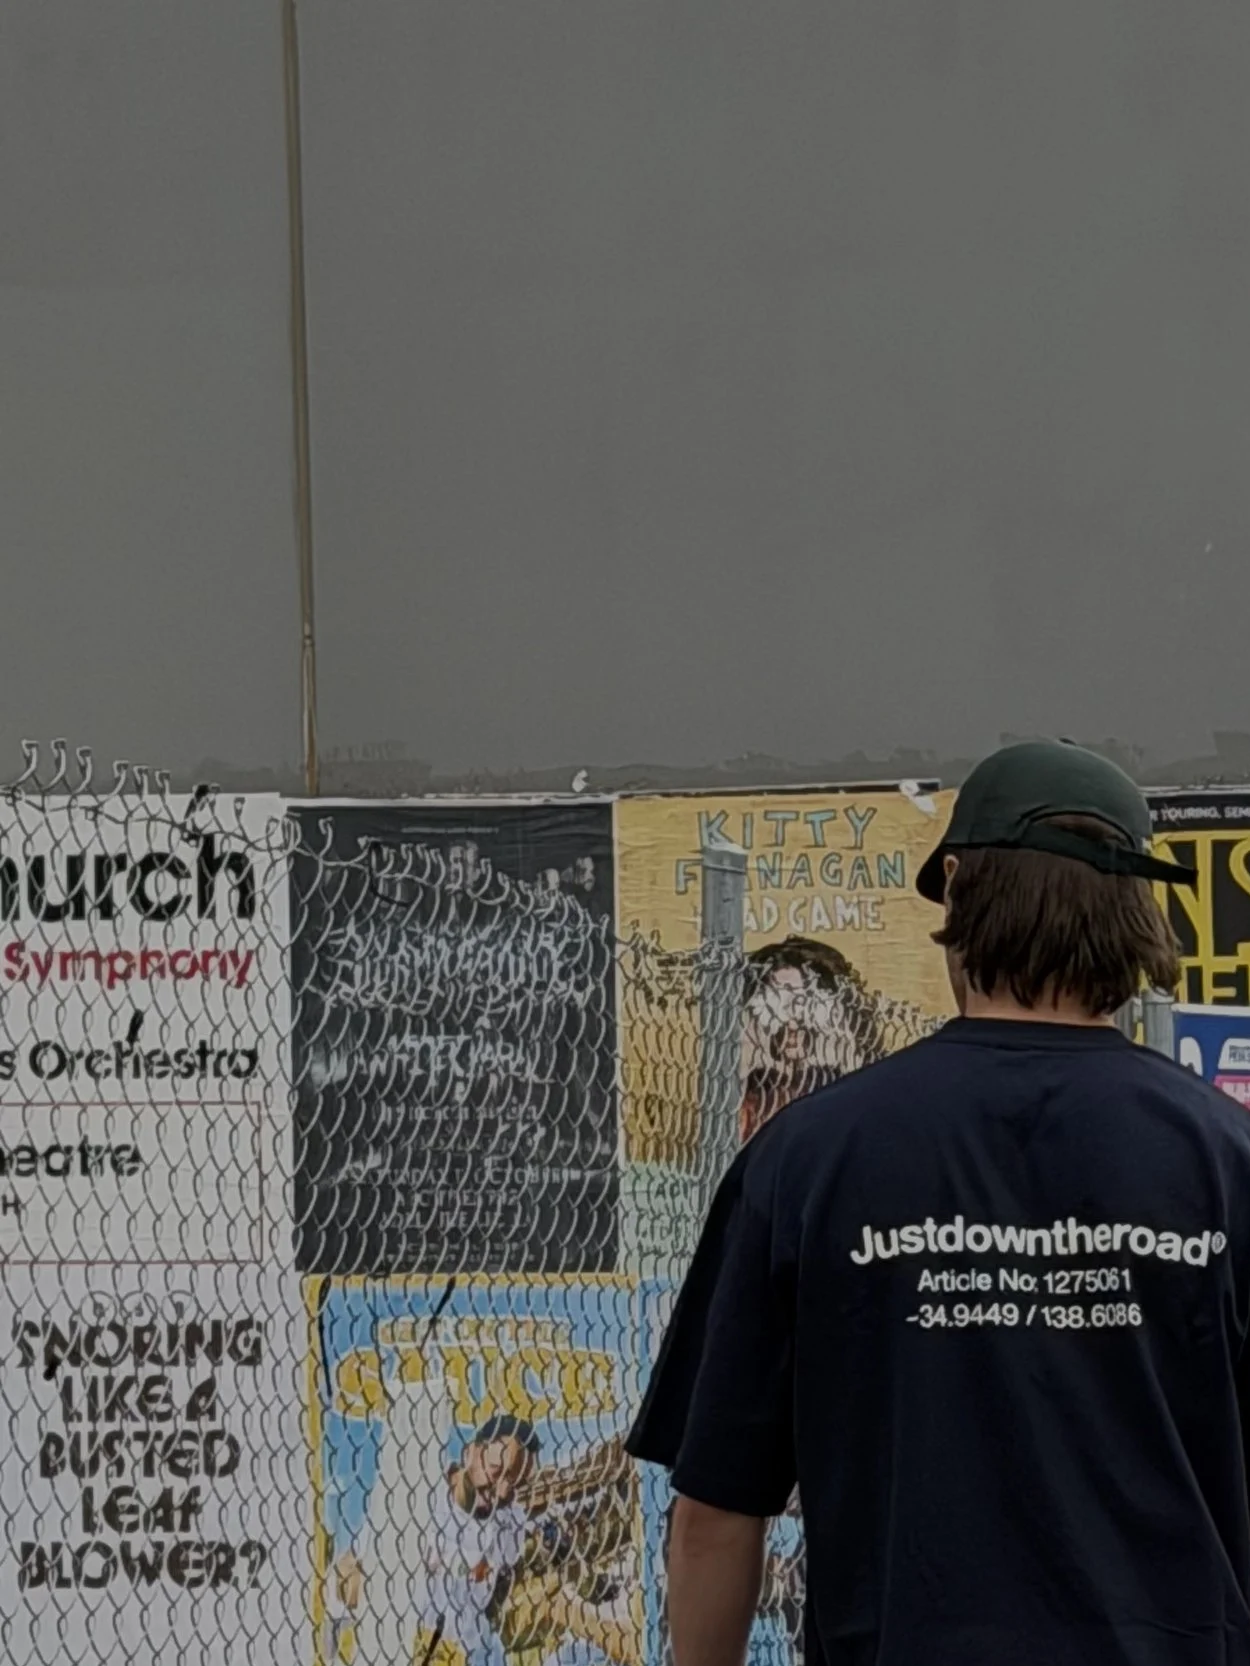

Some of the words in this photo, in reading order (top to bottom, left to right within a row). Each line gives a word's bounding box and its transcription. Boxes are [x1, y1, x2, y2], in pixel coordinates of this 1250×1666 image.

[697, 805, 877, 849] KITTY
[674, 852, 906, 895] FNAGAN
[787, 895, 885, 932] GAME
[4, 941, 254, 990] Symphony
[29, 1039, 258, 1081] Orchestra
[918, 1268, 991, 1292] Article
[906, 1304, 1018, 1328] -34.9449
[1025, 1305, 1037, 1327] /
[1041, 1303, 1142, 1329] 138.6086
[12, 1318, 263, 1368] SNORING
[62, 1375, 174, 1422] LIKE
[186, 1377, 217, 1422] A
[39, 1430, 241, 1478] BUSTED
[82, 1485, 201, 1534] LEAF
[18, 1539, 267, 1589] BLOWER?
